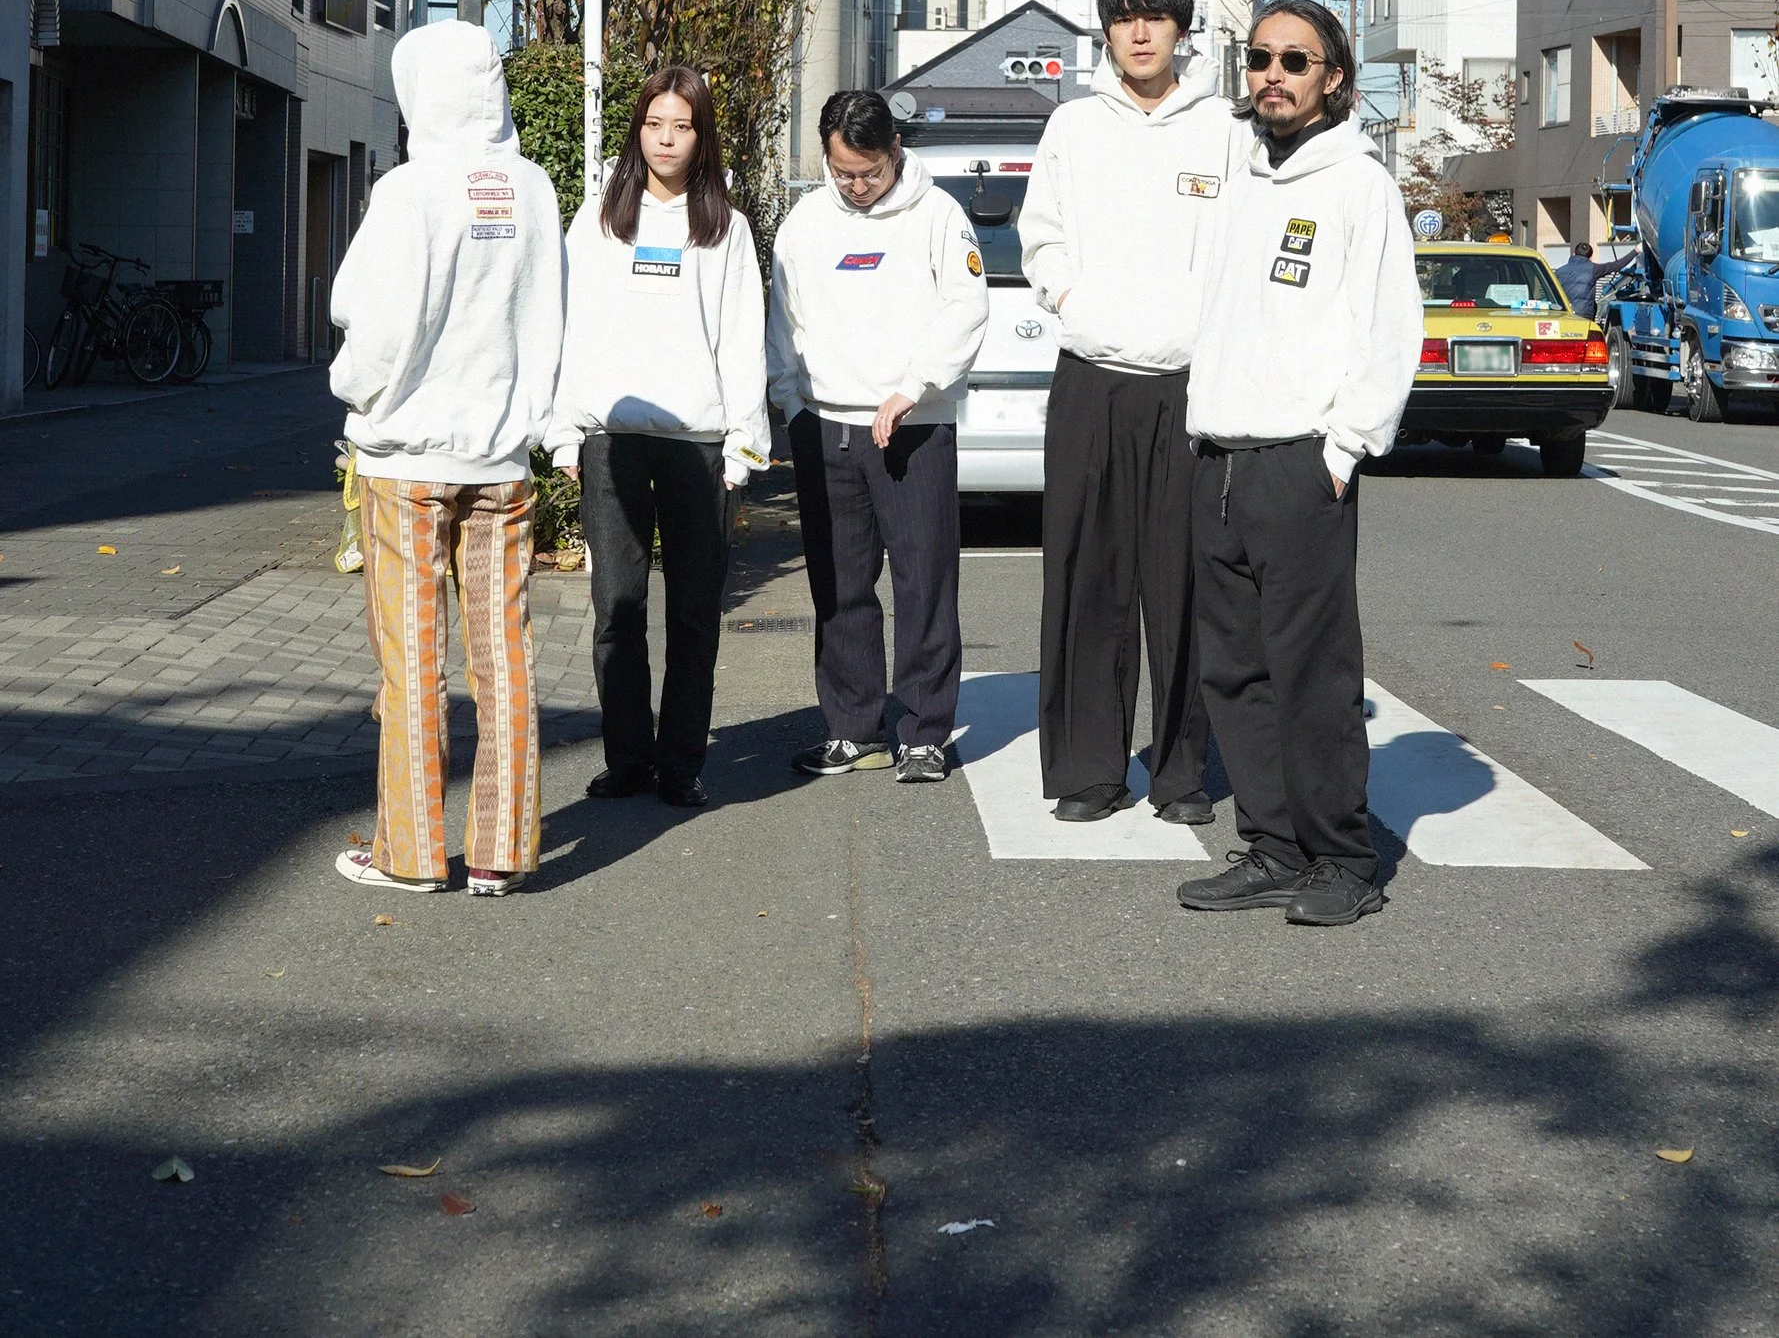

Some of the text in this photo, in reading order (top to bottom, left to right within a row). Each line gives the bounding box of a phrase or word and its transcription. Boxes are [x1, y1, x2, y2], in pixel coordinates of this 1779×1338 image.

[1181, 177, 1216, 186] CONTOGA
[1288, 236, 1308, 250] CAT
[634, 263, 678, 276] HOBART
[1274, 260, 1308, 282] CAT
